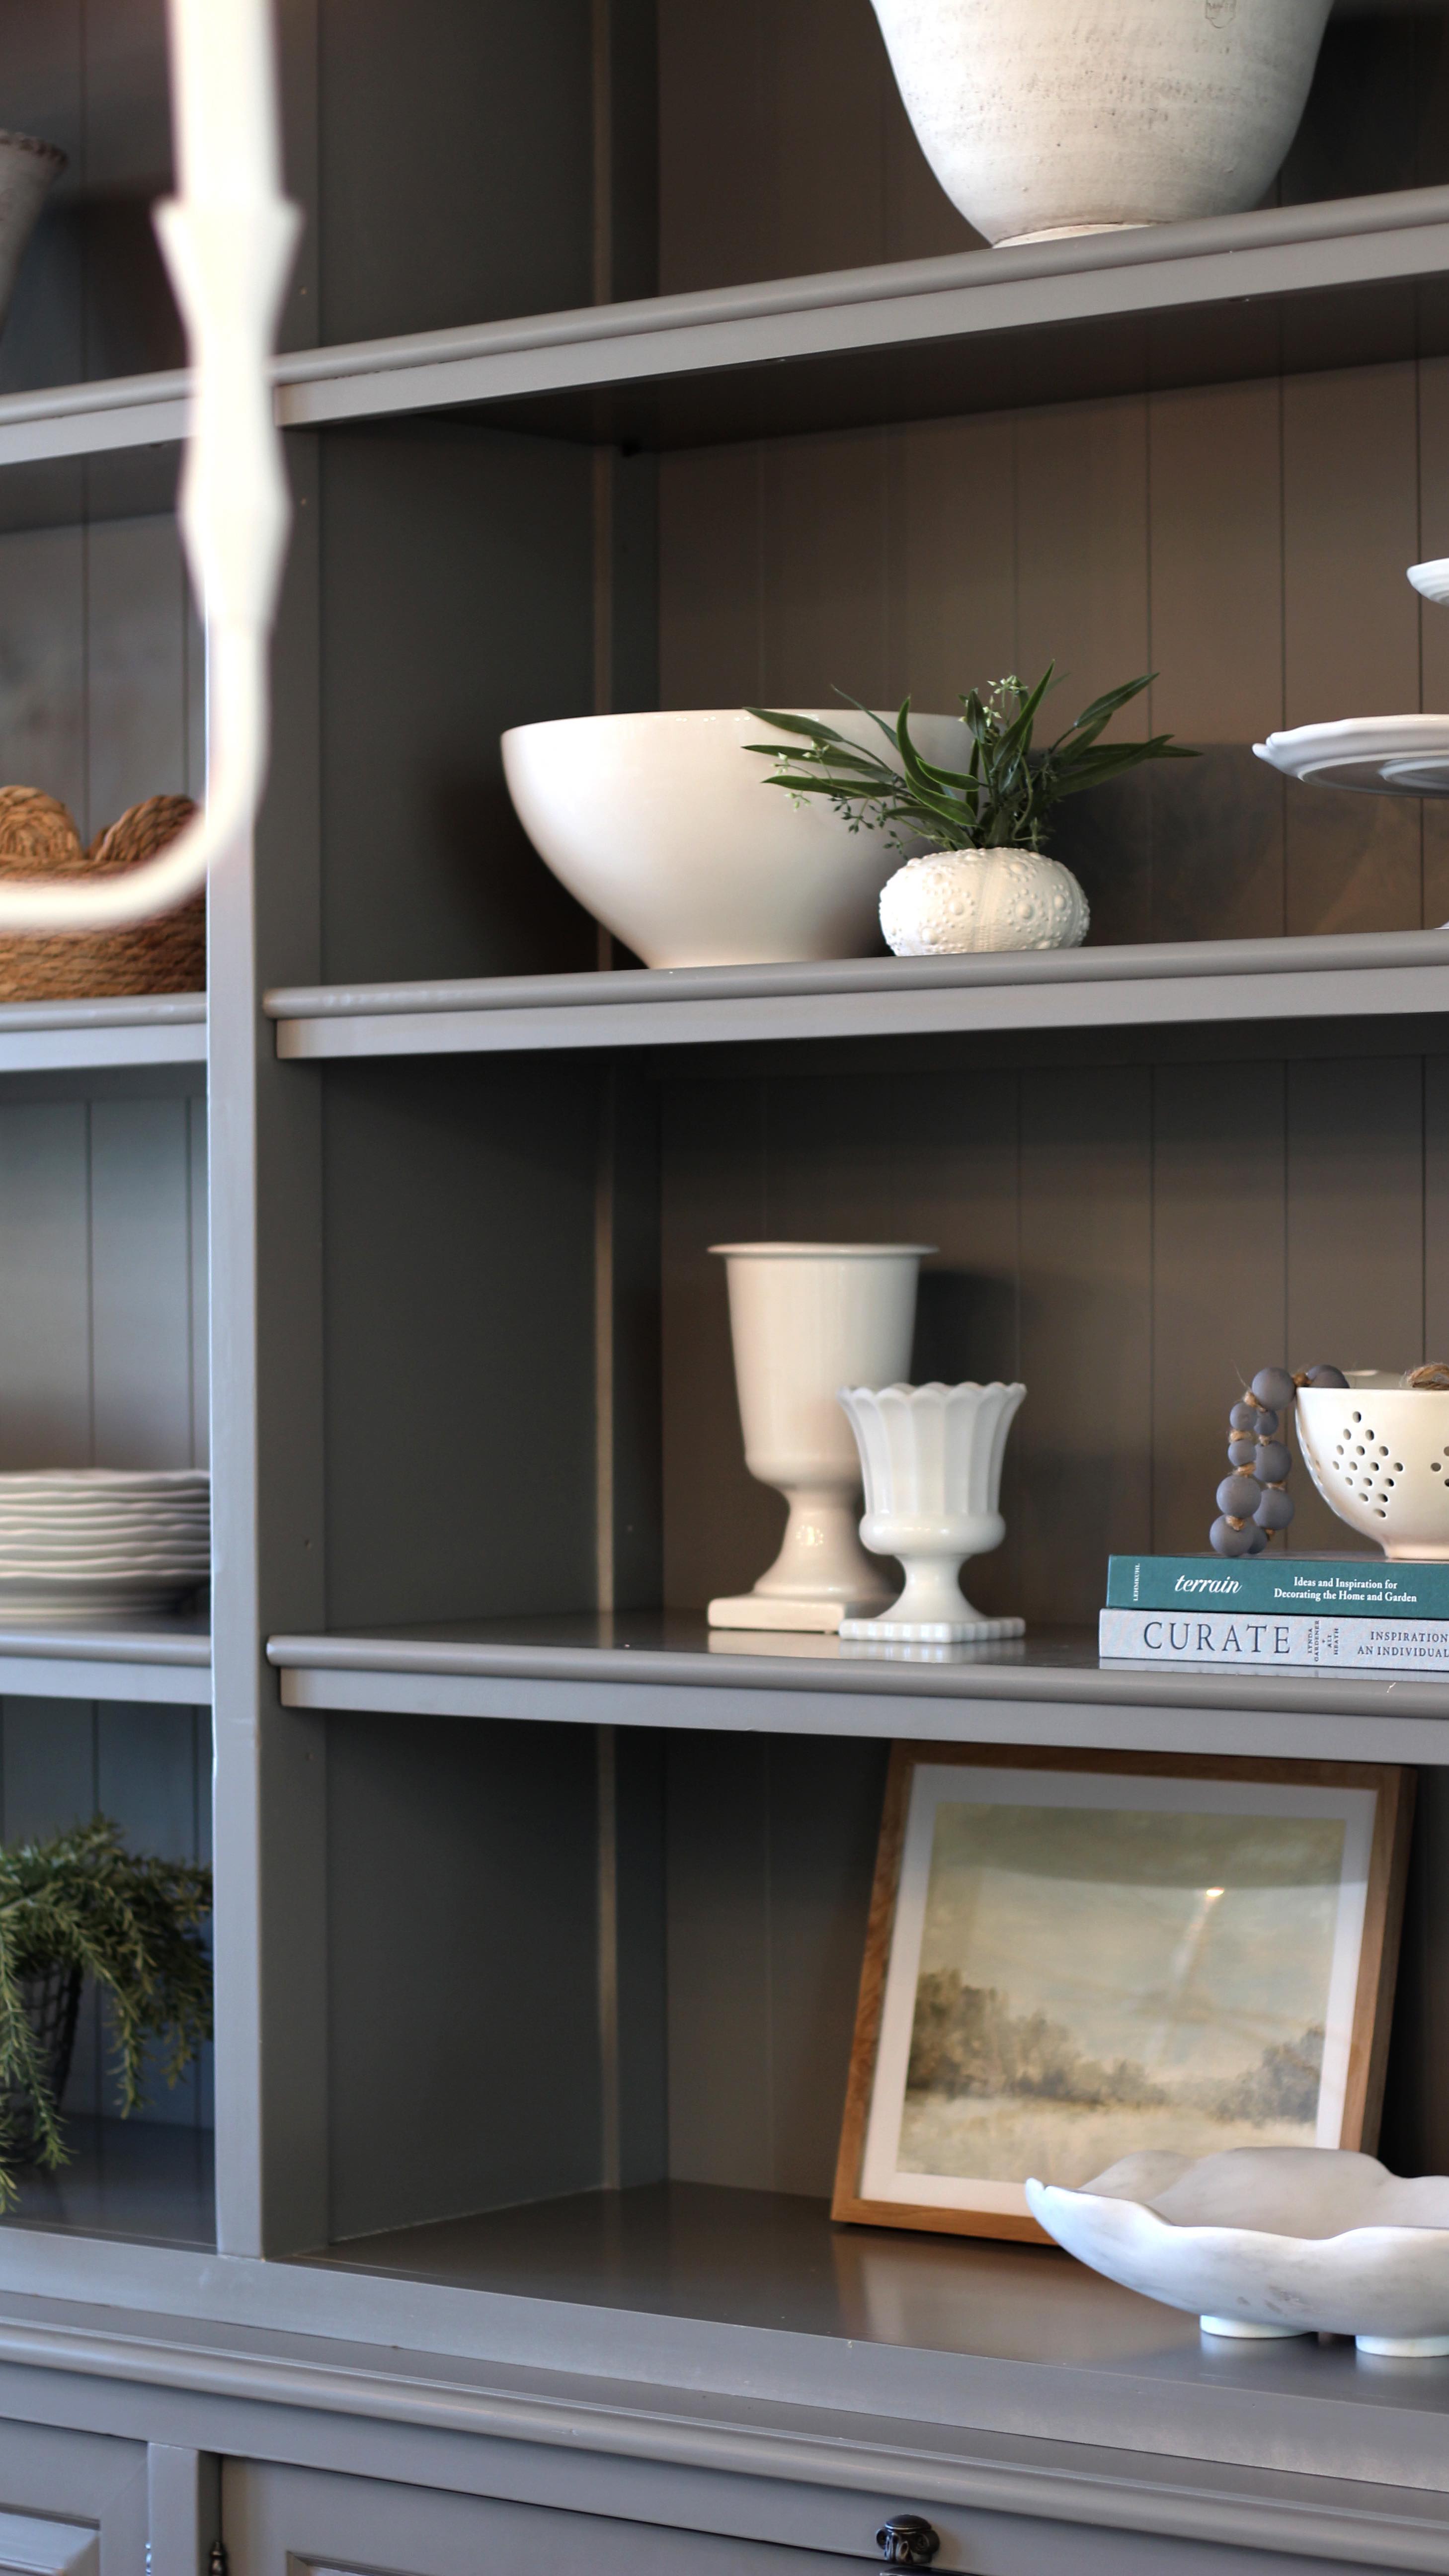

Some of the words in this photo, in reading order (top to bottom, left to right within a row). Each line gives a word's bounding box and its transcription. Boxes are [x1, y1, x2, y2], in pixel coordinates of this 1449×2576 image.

[1175, 1575, 1242, 1594] terrain
[1294, 1576, 1316, 1587] Ideas
[1317, 1577, 1334, 1587] and
[1335, 1578, 1383, 1591] Inspiration
[1384, 1579, 1398, 1589] for
[1274, 1588, 1321, 1602] Decorating
[1323, 1590, 1337, 1600] the
[1338, 1590, 1365, 1601] Home
[1367, 1591, 1383, 1601] and
[1384, 1592, 1417, 1602] Garden
[1143, 1621, 1290, 1654] CURATE
[1370, 1631, 1449, 1642] INSPIRATION
[1357, 1646, 1373, 1655] AN
[1377, 1646, 1449, 1658] INDIVIDUAL
